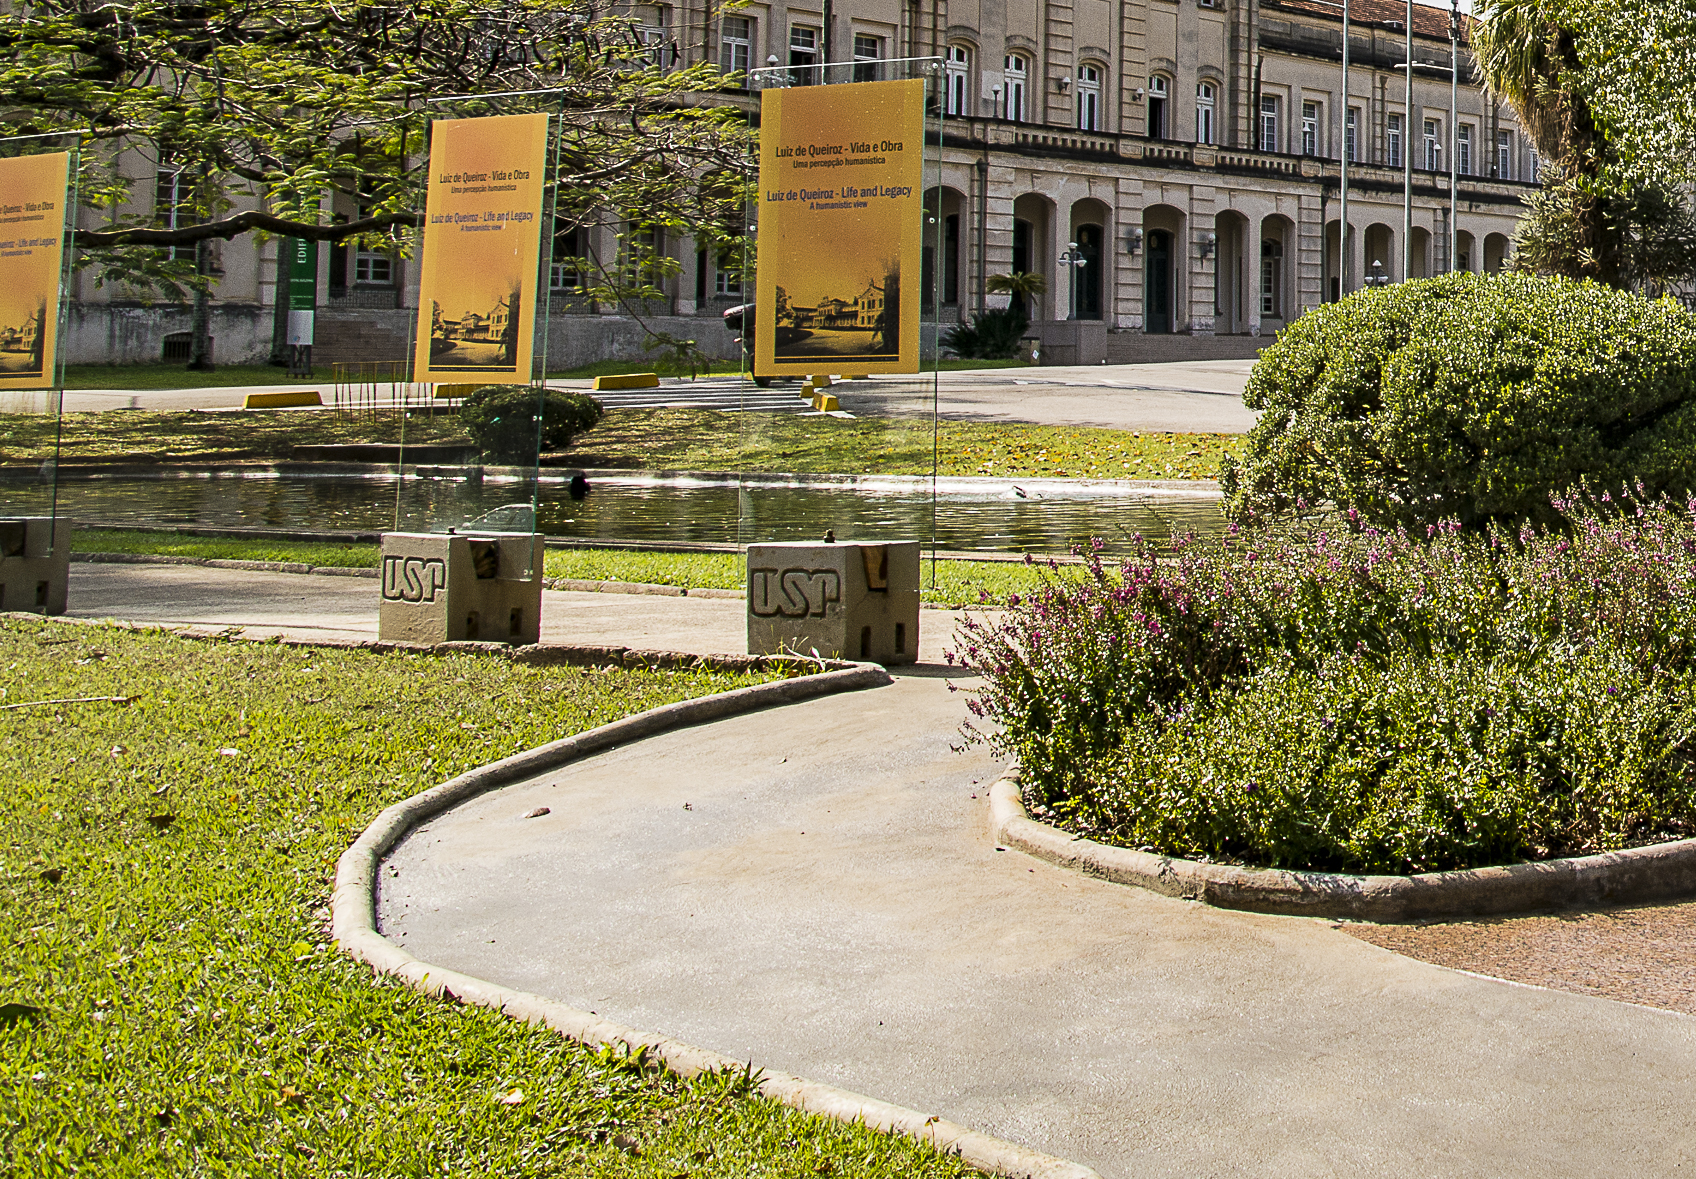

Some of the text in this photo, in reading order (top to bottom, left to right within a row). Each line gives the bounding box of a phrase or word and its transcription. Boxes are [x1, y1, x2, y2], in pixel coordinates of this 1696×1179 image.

[776, 146, 793, 157] Luiz
[795, 146, 806, 156] de
[808, 144, 843, 157] Queiroz
[850, 142, 870, 153] Vida
[873, 144, 878, 152] e
[880, 140, 903, 152] Obra
[793, 156, 885, 169] Uma percepção humanística
[440, 174, 452, 183] Luiz
[453, 173, 461, 182] de
[463, 172, 487, 184] Queiroz
[492, 170, 507, 180] Vida
[507, 172, 513, 180] e
[514, 169, 529, 179] Obra
[767, 190, 784, 202] Luiz
[786, 190, 797, 201] de
[800, 188, 834, 202] Queiroz
[841, 186, 858, 199] Life
[860, 185, 878, 197] and
[880, 185, 912, 198] Legacy
[816, 200, 852, 210] humanistic
[484, 211, 495, 221] Life
[511, 211, 534, 223] Legacy
[383, 555, 446, 604] USP
[750, 567, 841, 619] USP
